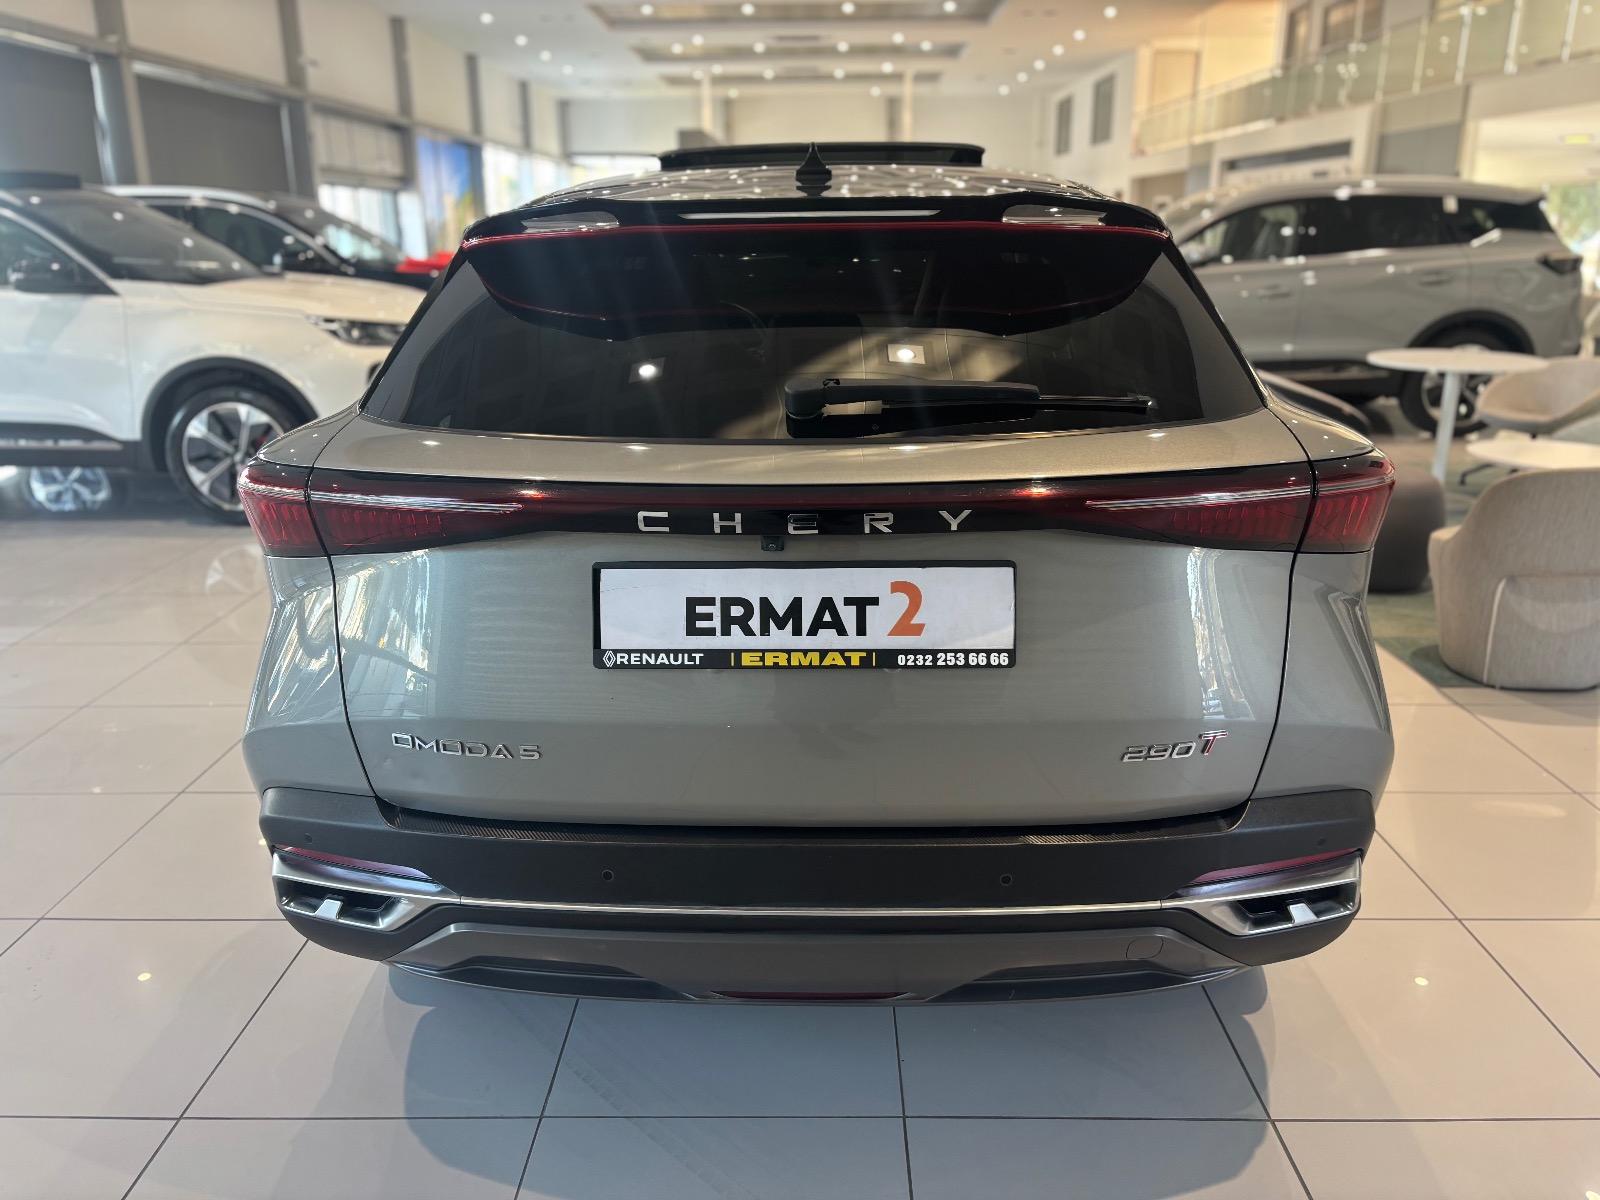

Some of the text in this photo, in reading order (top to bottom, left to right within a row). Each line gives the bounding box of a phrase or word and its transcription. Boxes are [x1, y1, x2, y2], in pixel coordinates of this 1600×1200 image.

[637, 509, 972, 535] CHERY
[685, 580, 926, 637] ERMAT 2
[616, 653, 704, 665] RENAULT
[741, 652, 867, 666] ERMAT
[897, 654, 933, 666] 0232
[936, 652, 965, 666] 253
[391, 731, 541, 760] OMODA 5
